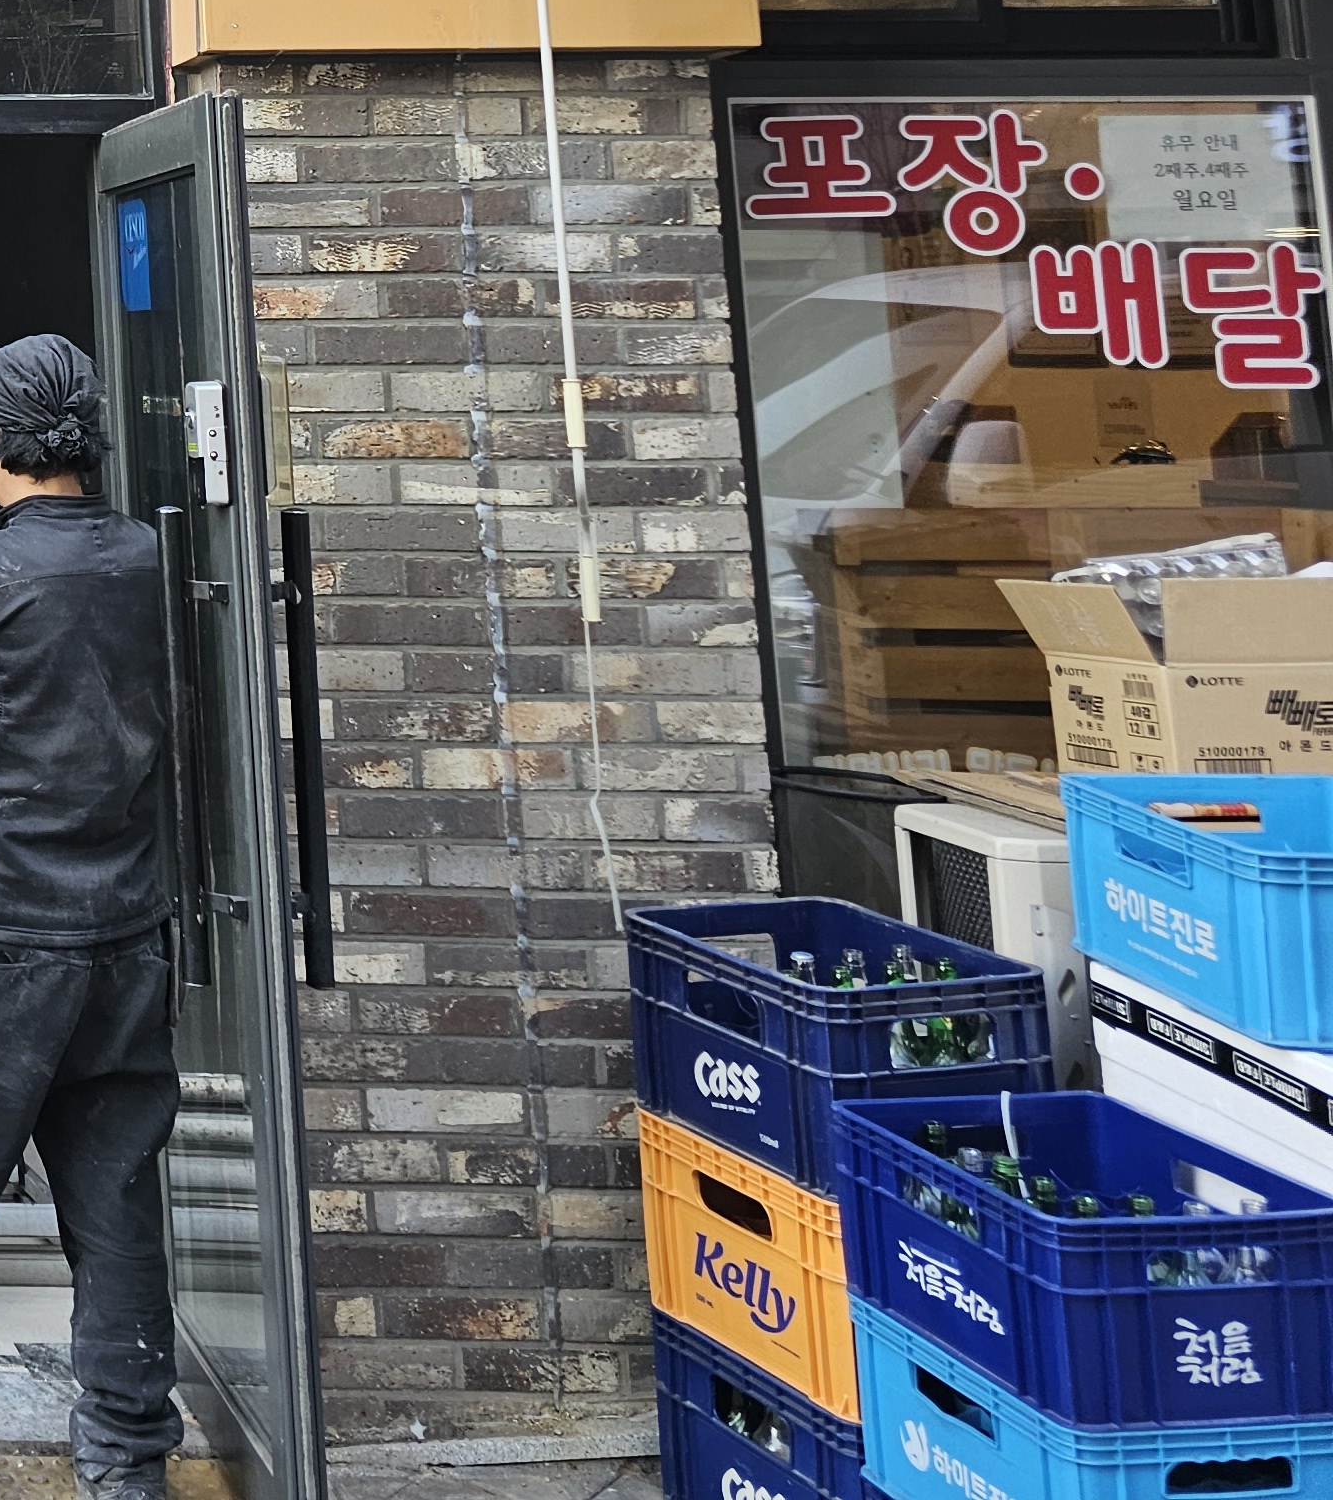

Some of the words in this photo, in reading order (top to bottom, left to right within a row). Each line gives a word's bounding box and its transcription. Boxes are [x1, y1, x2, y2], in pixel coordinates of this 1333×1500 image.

[1159, 133, 1197, 153] 휴무
[1204, 132, 1240, 152] 안내
[1171, 187, 1238, 213] 월요일
[1029, 239, 1325, 390] 배달
[1063, 667, 1093, 679] LOTTE
[1200, 676, 1245, 687] LOTTE
[1103, 876, 1219, 962] 하이트진로
[693, 1050, 761, 1104] Cass
[693, 1231, 797, 1334] Kelly
[897, 1238, 1007, 1337] 처음처럼
[1172, 1316, 1253, 1357] 처음
[1175, 1355, 1265, 1388] 처럼
